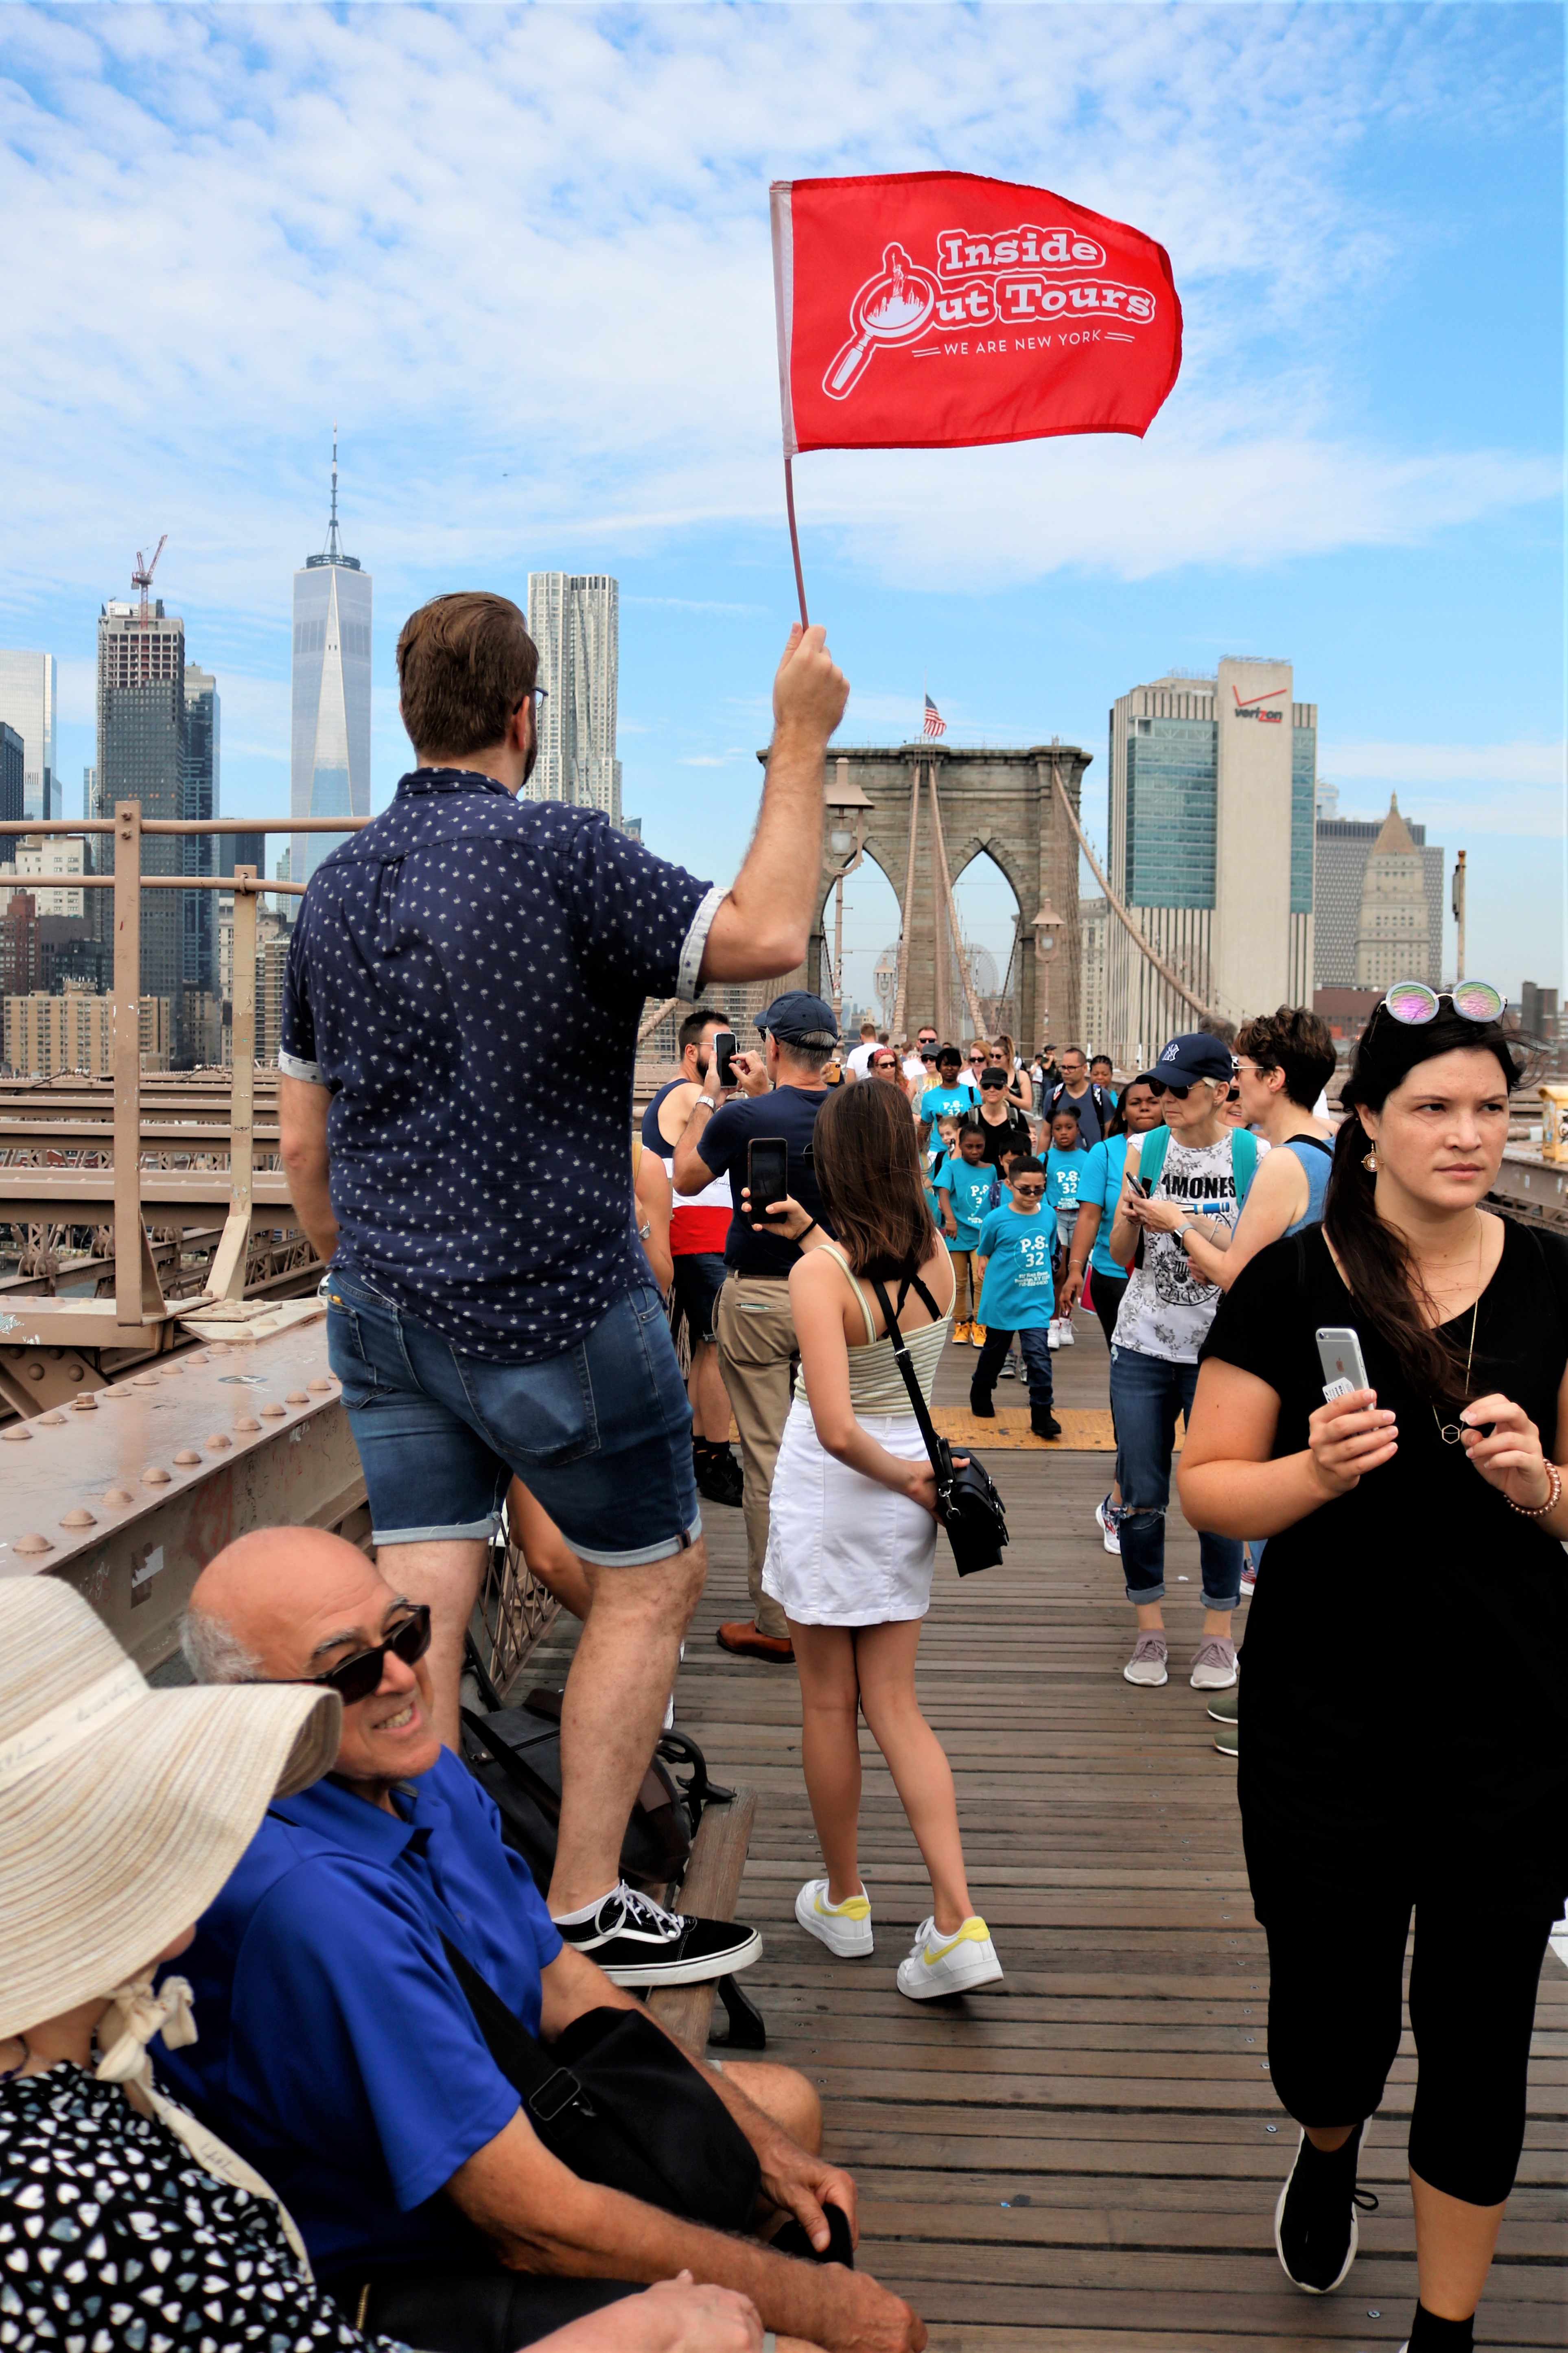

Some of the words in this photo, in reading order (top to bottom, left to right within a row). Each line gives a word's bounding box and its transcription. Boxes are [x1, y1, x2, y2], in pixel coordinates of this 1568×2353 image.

[945, 232, 1098, 270] Inside
[1006, 283, 1150, 316] Tours
[944, 343, 968, 355] WE
[976, 340, 1007, 354] ARE
[1015, 336, 1052, 350] NEW
[1058, 329, 1101, 346] YORK
[1234, 707, 1283, 723] verizon
[943, 1100, 963, 1110] P.S.
[1056, 1170, 1080, 1183] P.S.
[1062, 1182, 1077, 1194] 32
[1019, 1235, 1049, 1253] P.S.
[1025, 1251, 1044, 1267] 32
